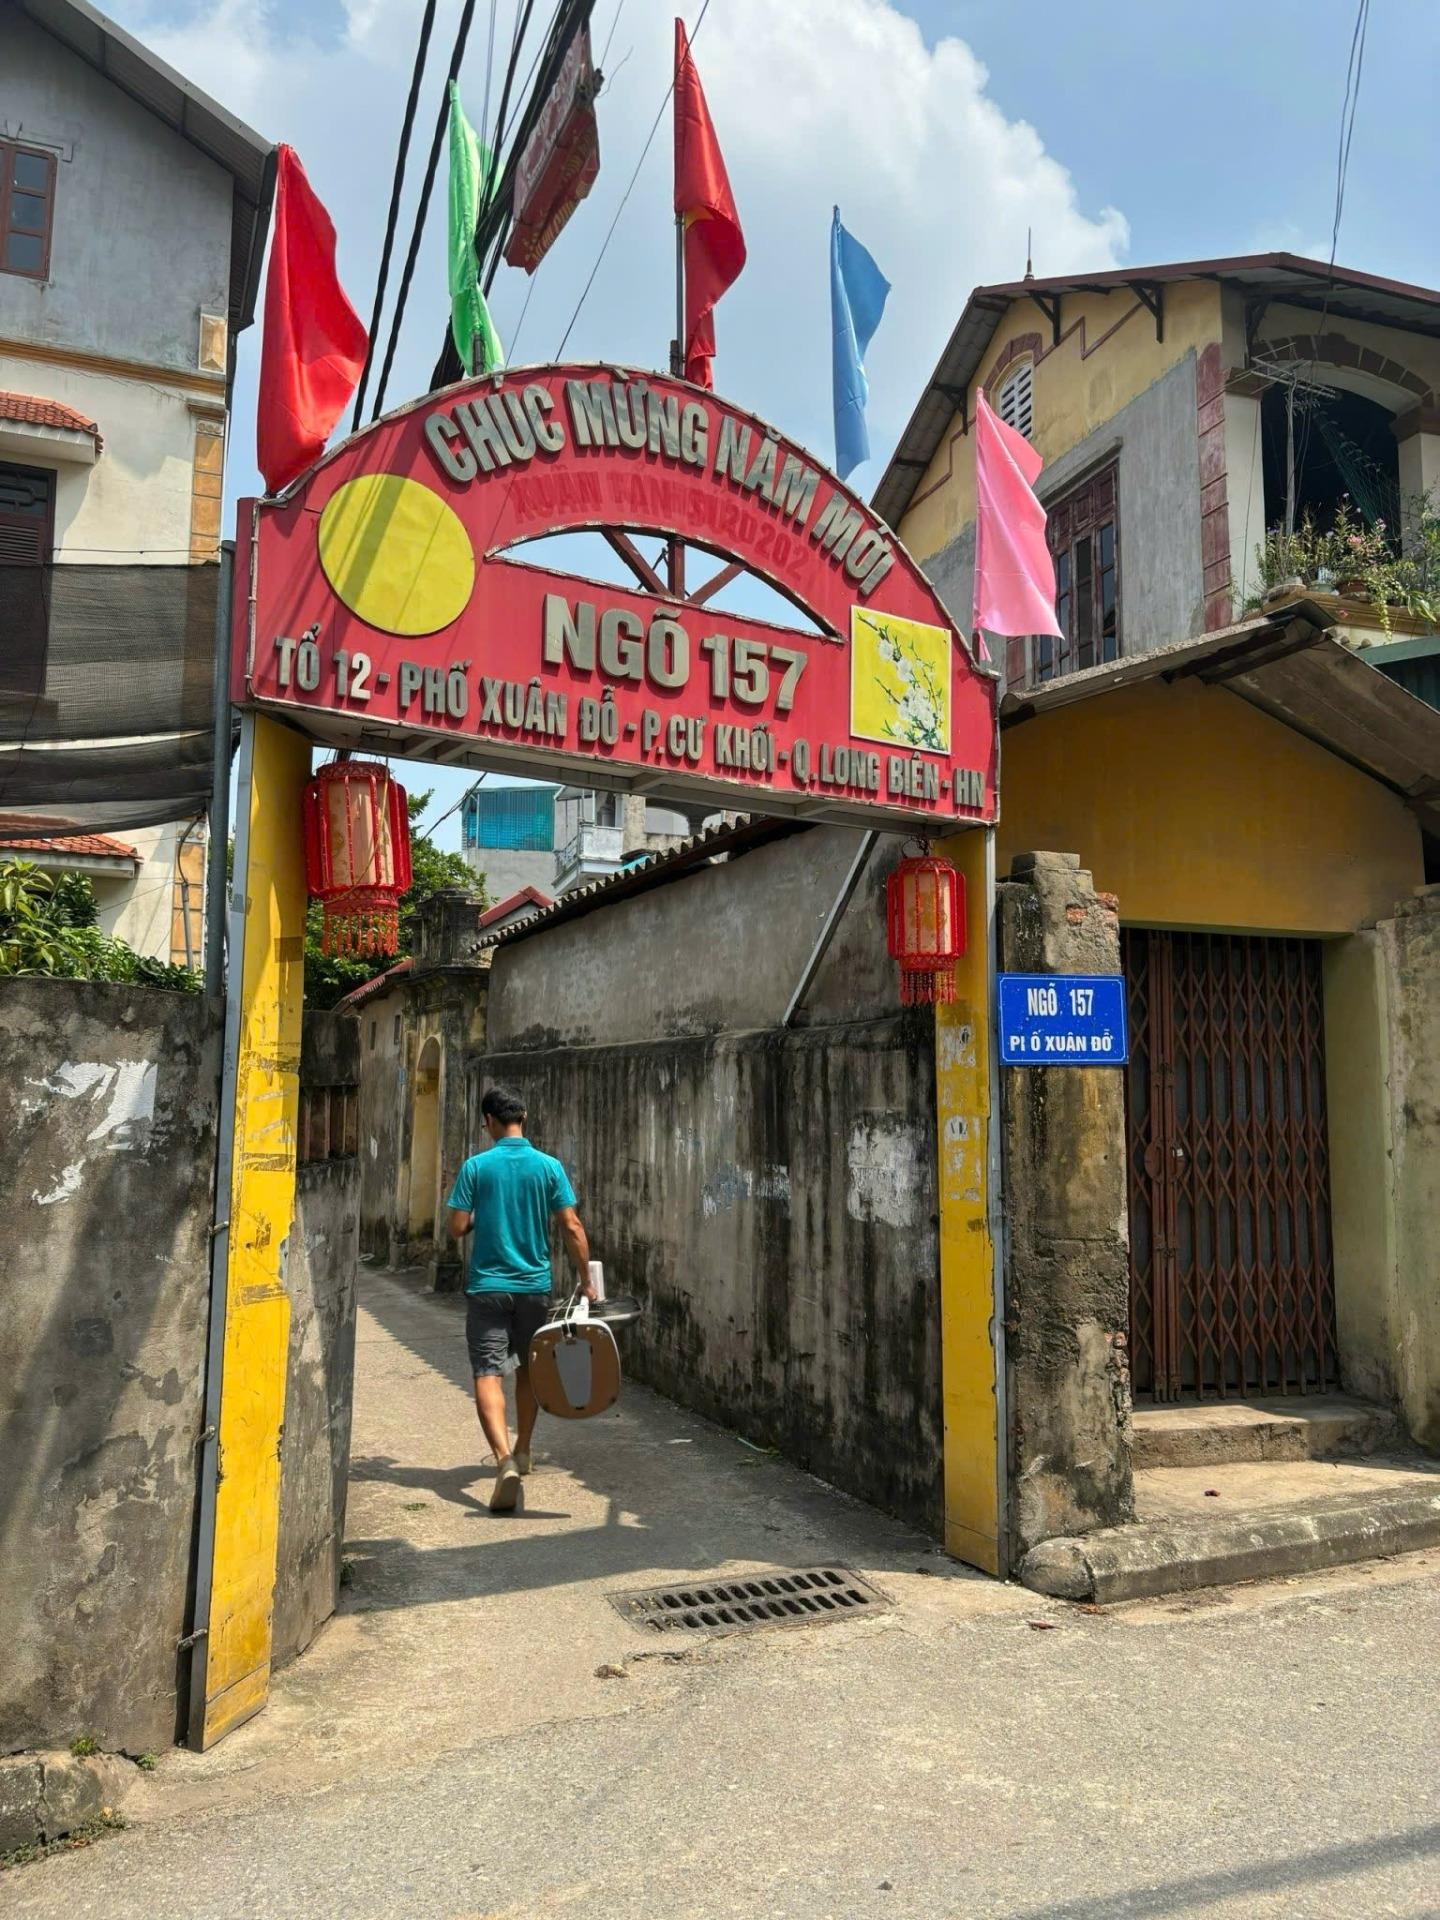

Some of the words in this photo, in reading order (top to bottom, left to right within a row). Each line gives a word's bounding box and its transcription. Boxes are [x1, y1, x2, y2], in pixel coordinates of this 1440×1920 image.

[424, 375, 565, 482] CHÚC
[564, 368, 709, 467] MỪNG
[714, 415, 821, 527] NĂM
[811, 491, 896, 597] MỚI
[543, 593, 690, 688] NGÕ
[701, 634, 808, 710] 157
[275, 623, 322, 691] TỔ
[333, 649, 372, 700] 12
[399, 659, 472, 719] PHỐ
[480, 676, 568, 737] XUÂN
[578, 684, 619, 746] ĐỖ
[887, 750, 940, 801] BIÊN
[953, 767, 985, 808] HN
[1026, 982, 1058, 1016] NGÕ
[1069, 988, 1094, 1016] 157
[1044, 1031, 1088, 1052] XUÂN
[1090, 1027, 1114, 1052] ĐỖ
